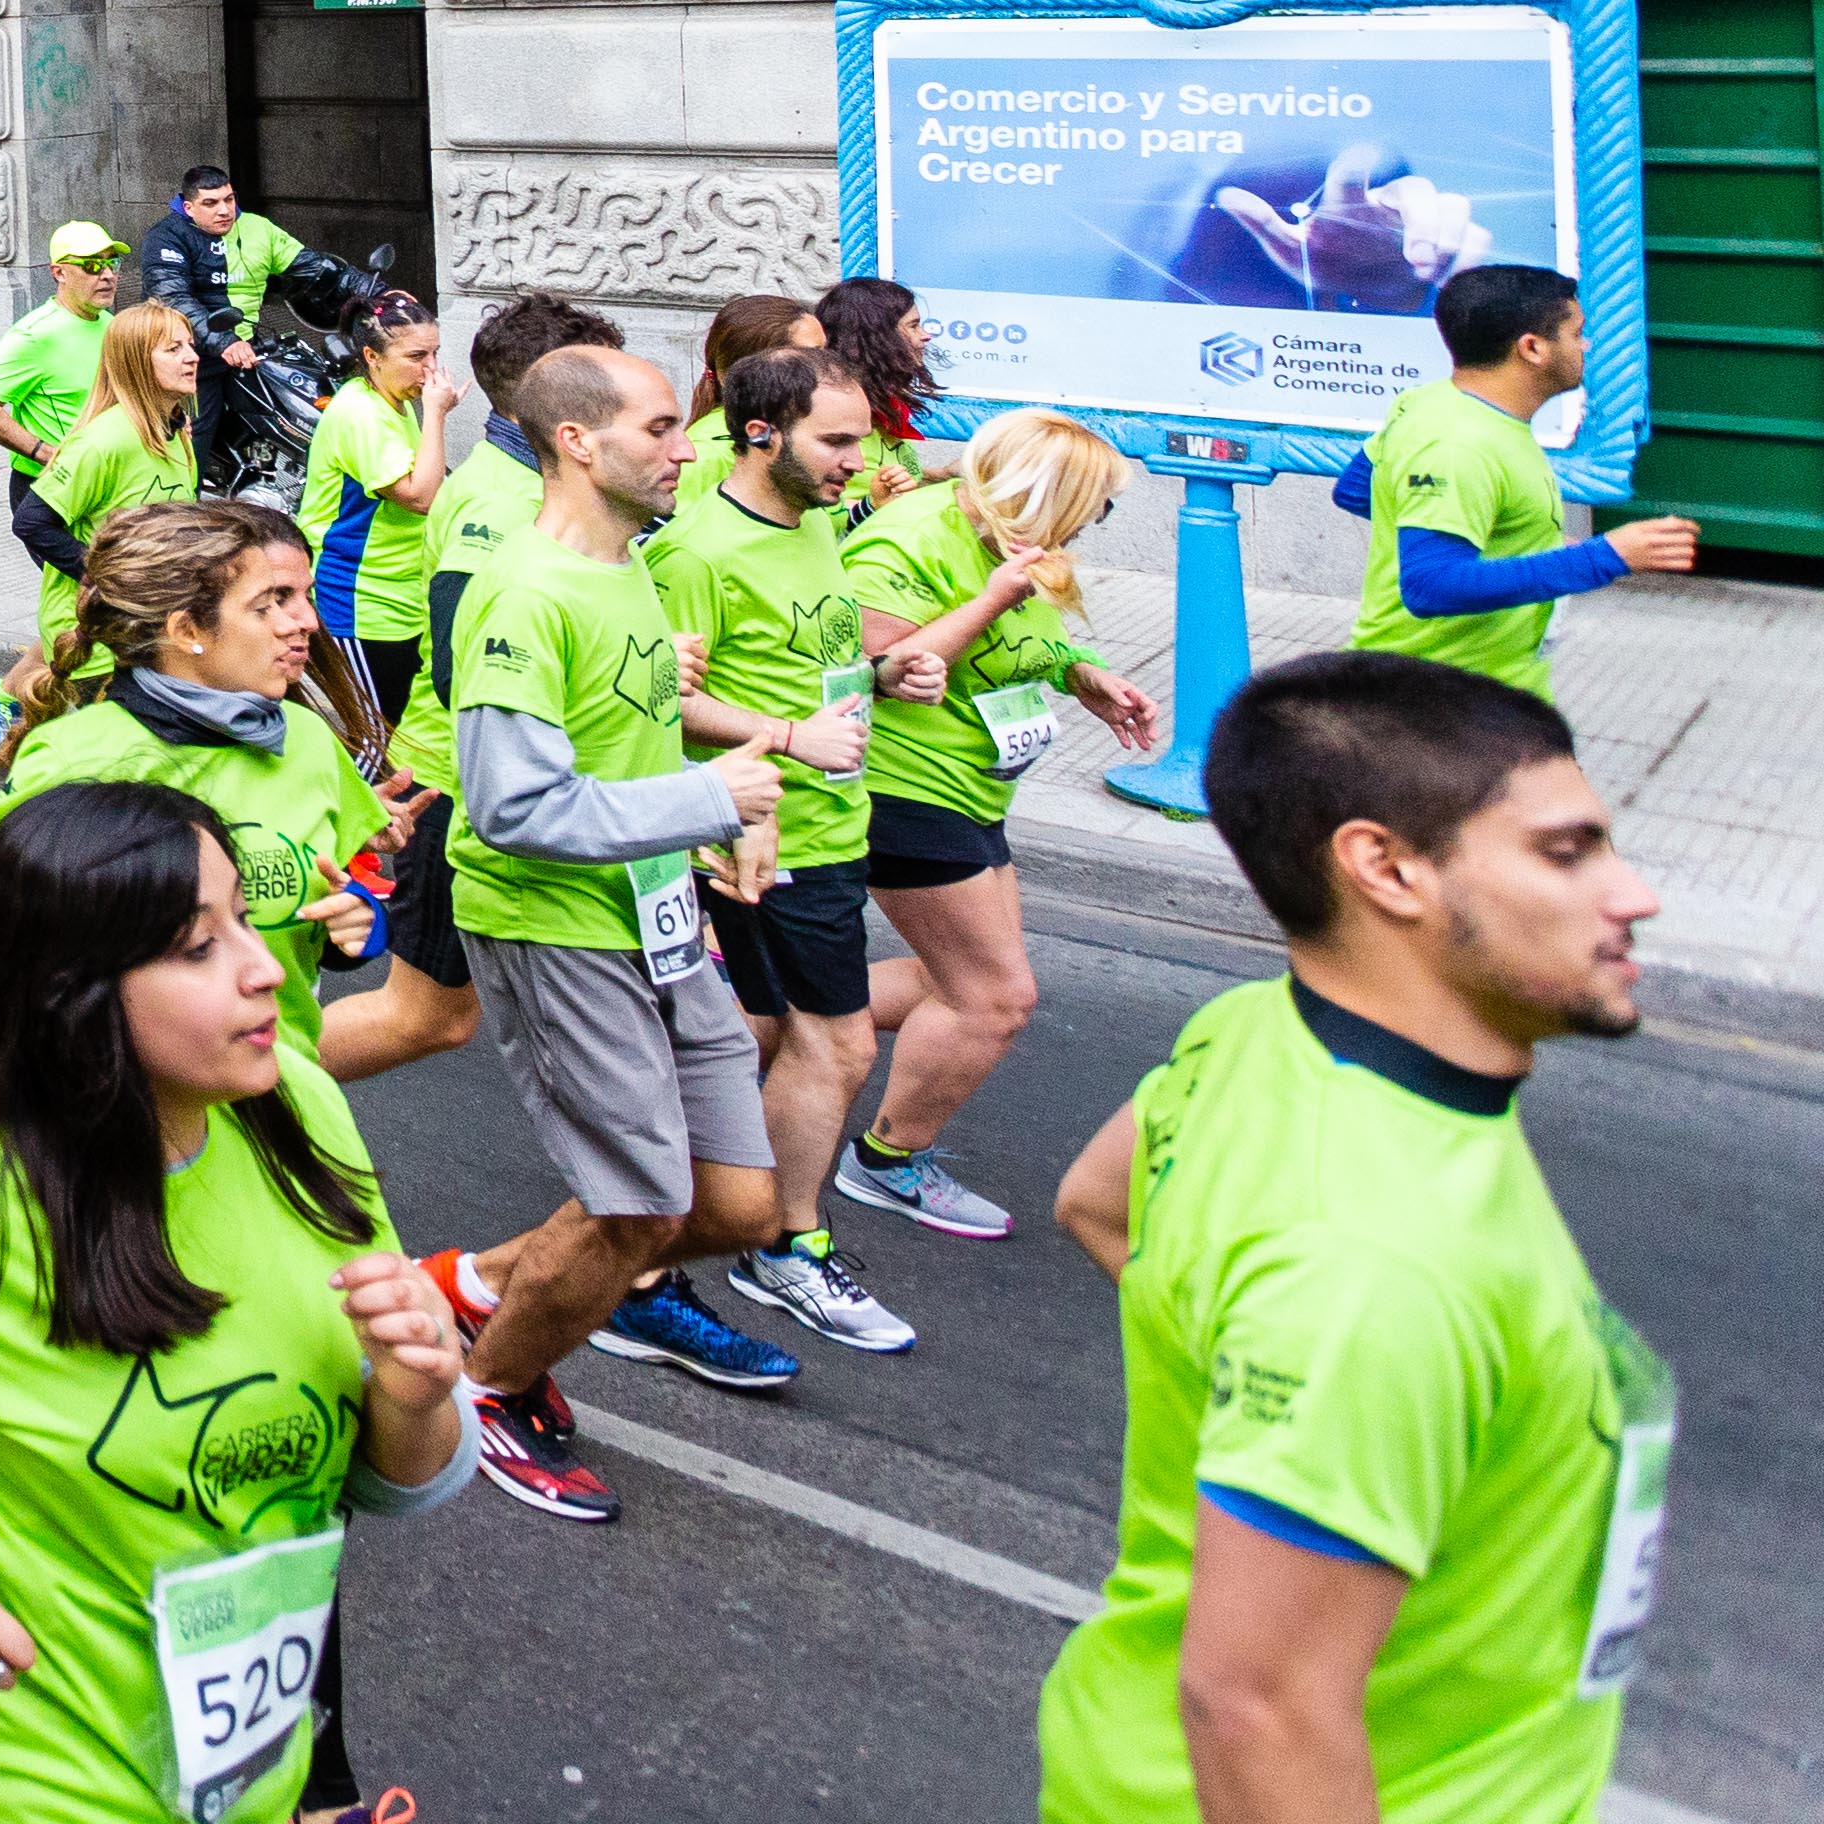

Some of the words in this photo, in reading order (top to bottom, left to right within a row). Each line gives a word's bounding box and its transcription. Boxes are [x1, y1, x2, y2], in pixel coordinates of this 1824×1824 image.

[916, 80, 1127, 114] Comercio
[1139, 89, 1165, 120] y
[1177, 84, 1373, 119] Servicio
[917, 117, 1126, 155] Argentino
[1140, 128, 1245, 158] para
[917, 153, 1063, 186] Crecer
[1272, 334, 1363, 355] Cámara
[1272, 354, 1387, 378] Argentina
[1391, 362, 1420, 379] de
[1272, 374, 1386, 398] Comercio
[1186, 435, 1230, 461] WS
[243, 877, 298, 902] ERDE
[203, 1410, 320, 1458] CARRERA
[201, 1431, 319, 1479] CIUDAD
[203, 1450, 313, 1509] VERDE
[179, 1613, 238, 1643] VERDE
[197, 1634, 314, 1748] 520
